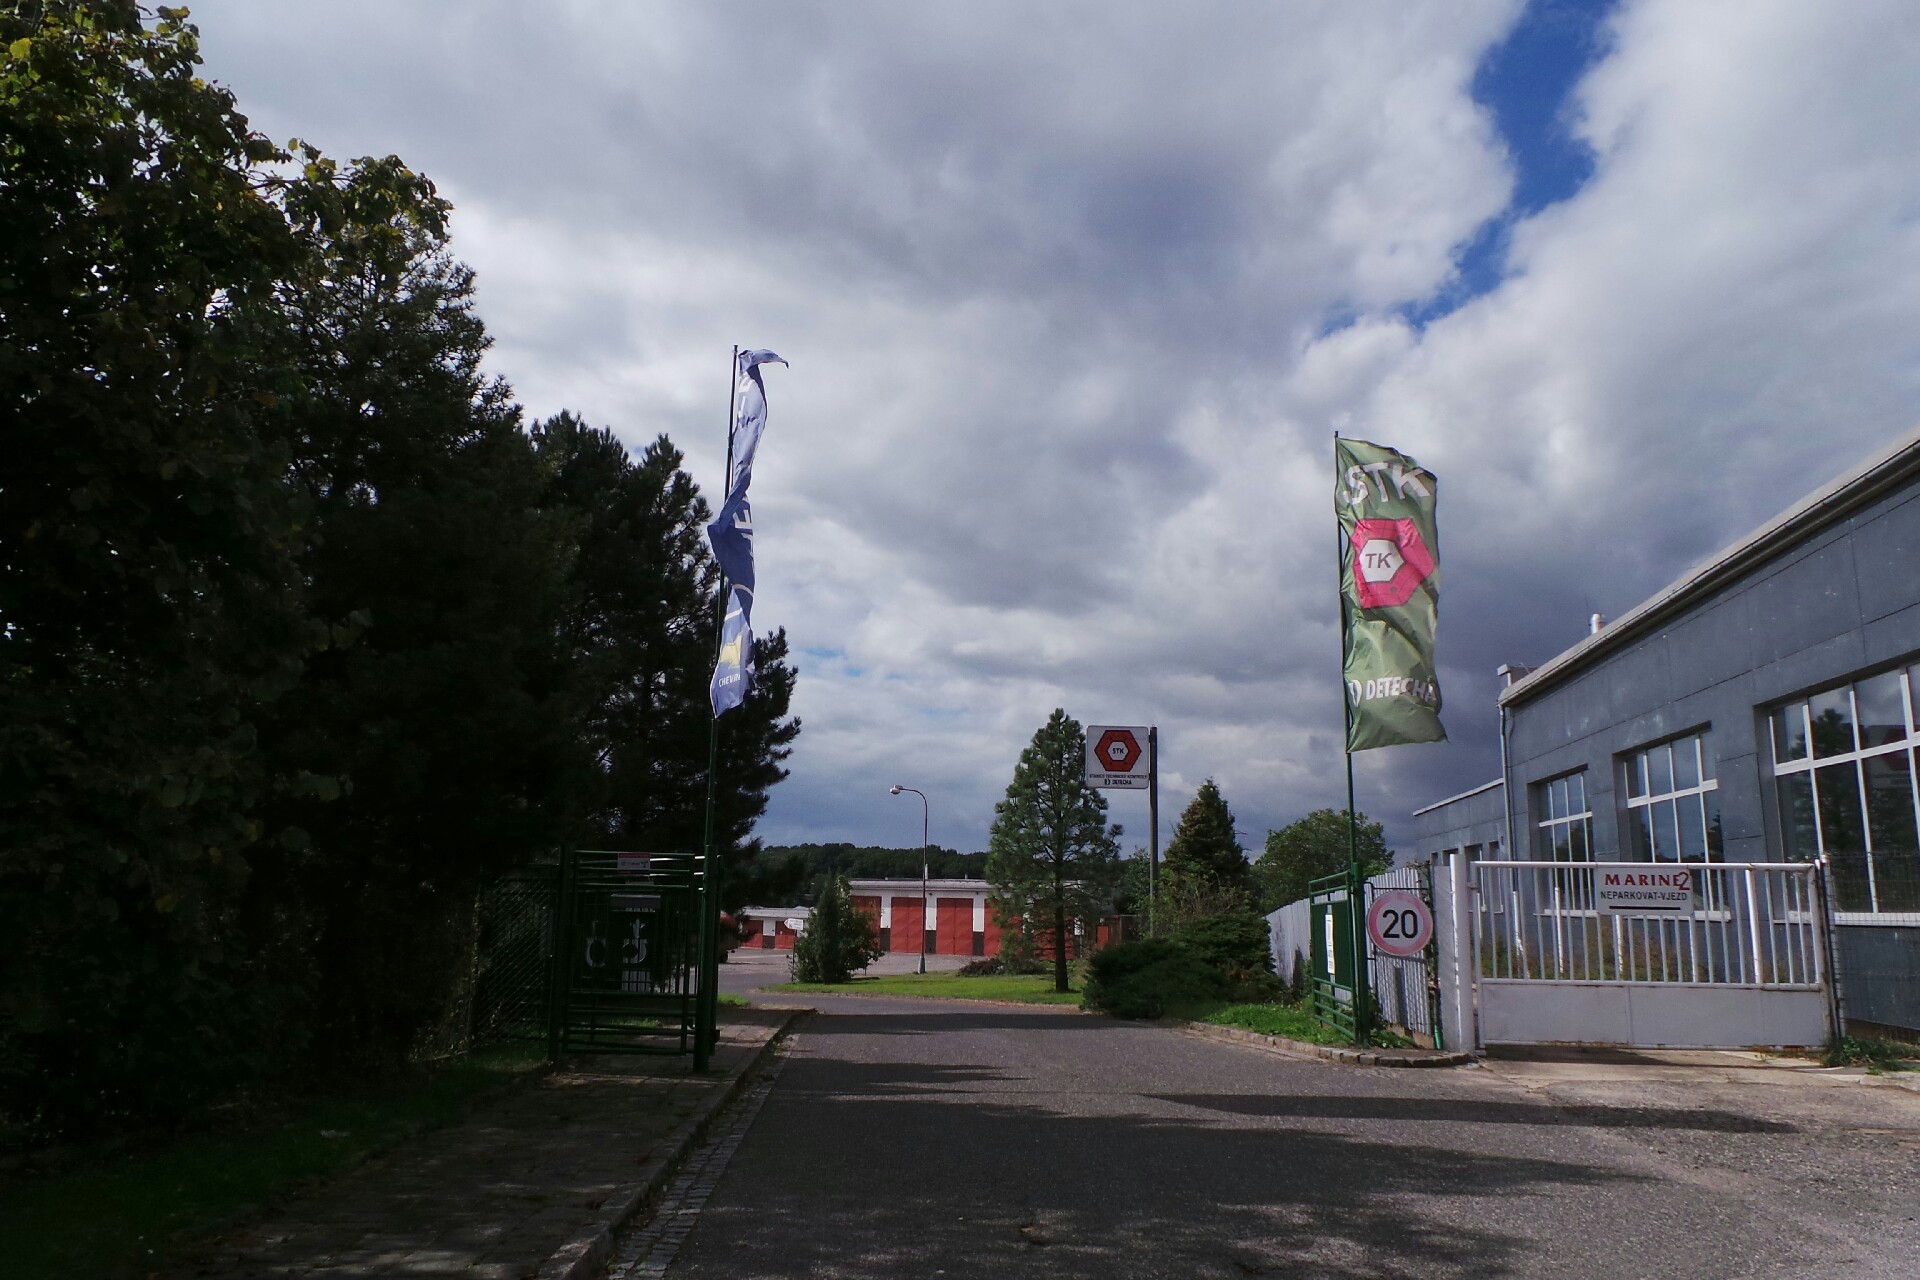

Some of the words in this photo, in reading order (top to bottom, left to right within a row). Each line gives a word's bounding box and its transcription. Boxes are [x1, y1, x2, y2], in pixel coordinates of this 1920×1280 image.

[1343, 462, 1431, 505] STK
[1366, 676, 1438, 703] DETECHA
[1382, 909, 1418, 939] 20
